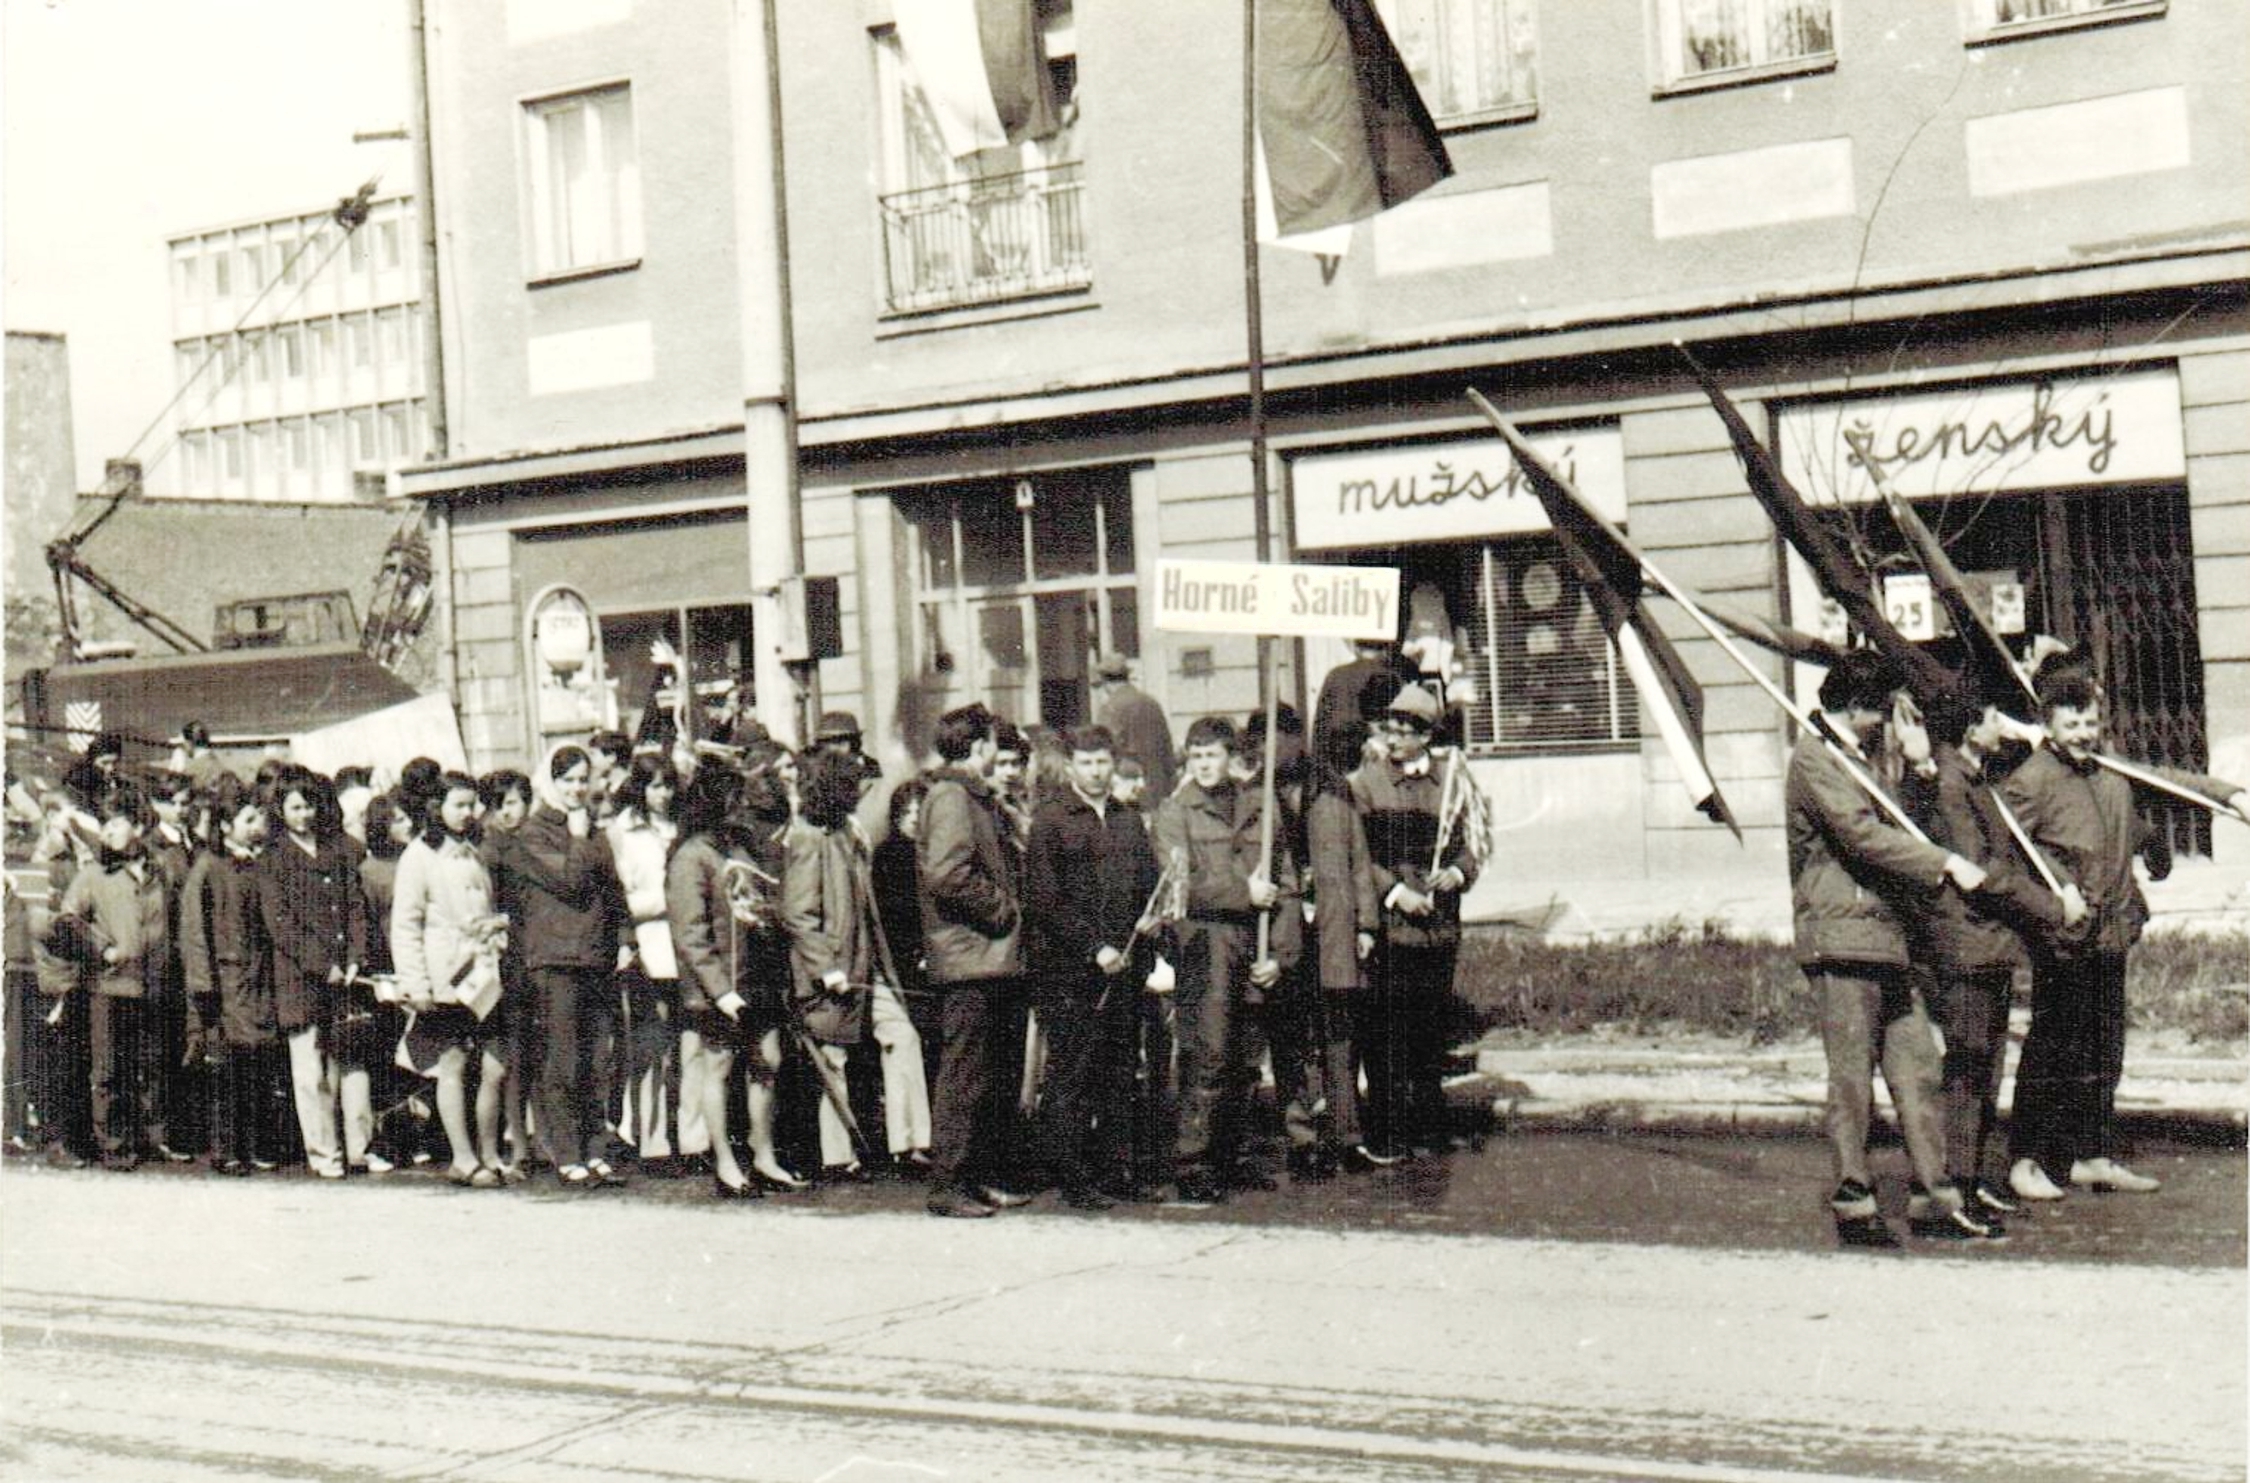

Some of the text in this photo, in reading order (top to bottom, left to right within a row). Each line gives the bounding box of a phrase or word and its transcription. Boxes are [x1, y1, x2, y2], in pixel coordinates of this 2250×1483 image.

[1846, 382, 2117, 474] ženský
[1163, 567, 1391, 630] Horné Saliby
[1893, 601, 1923, 630] 25
